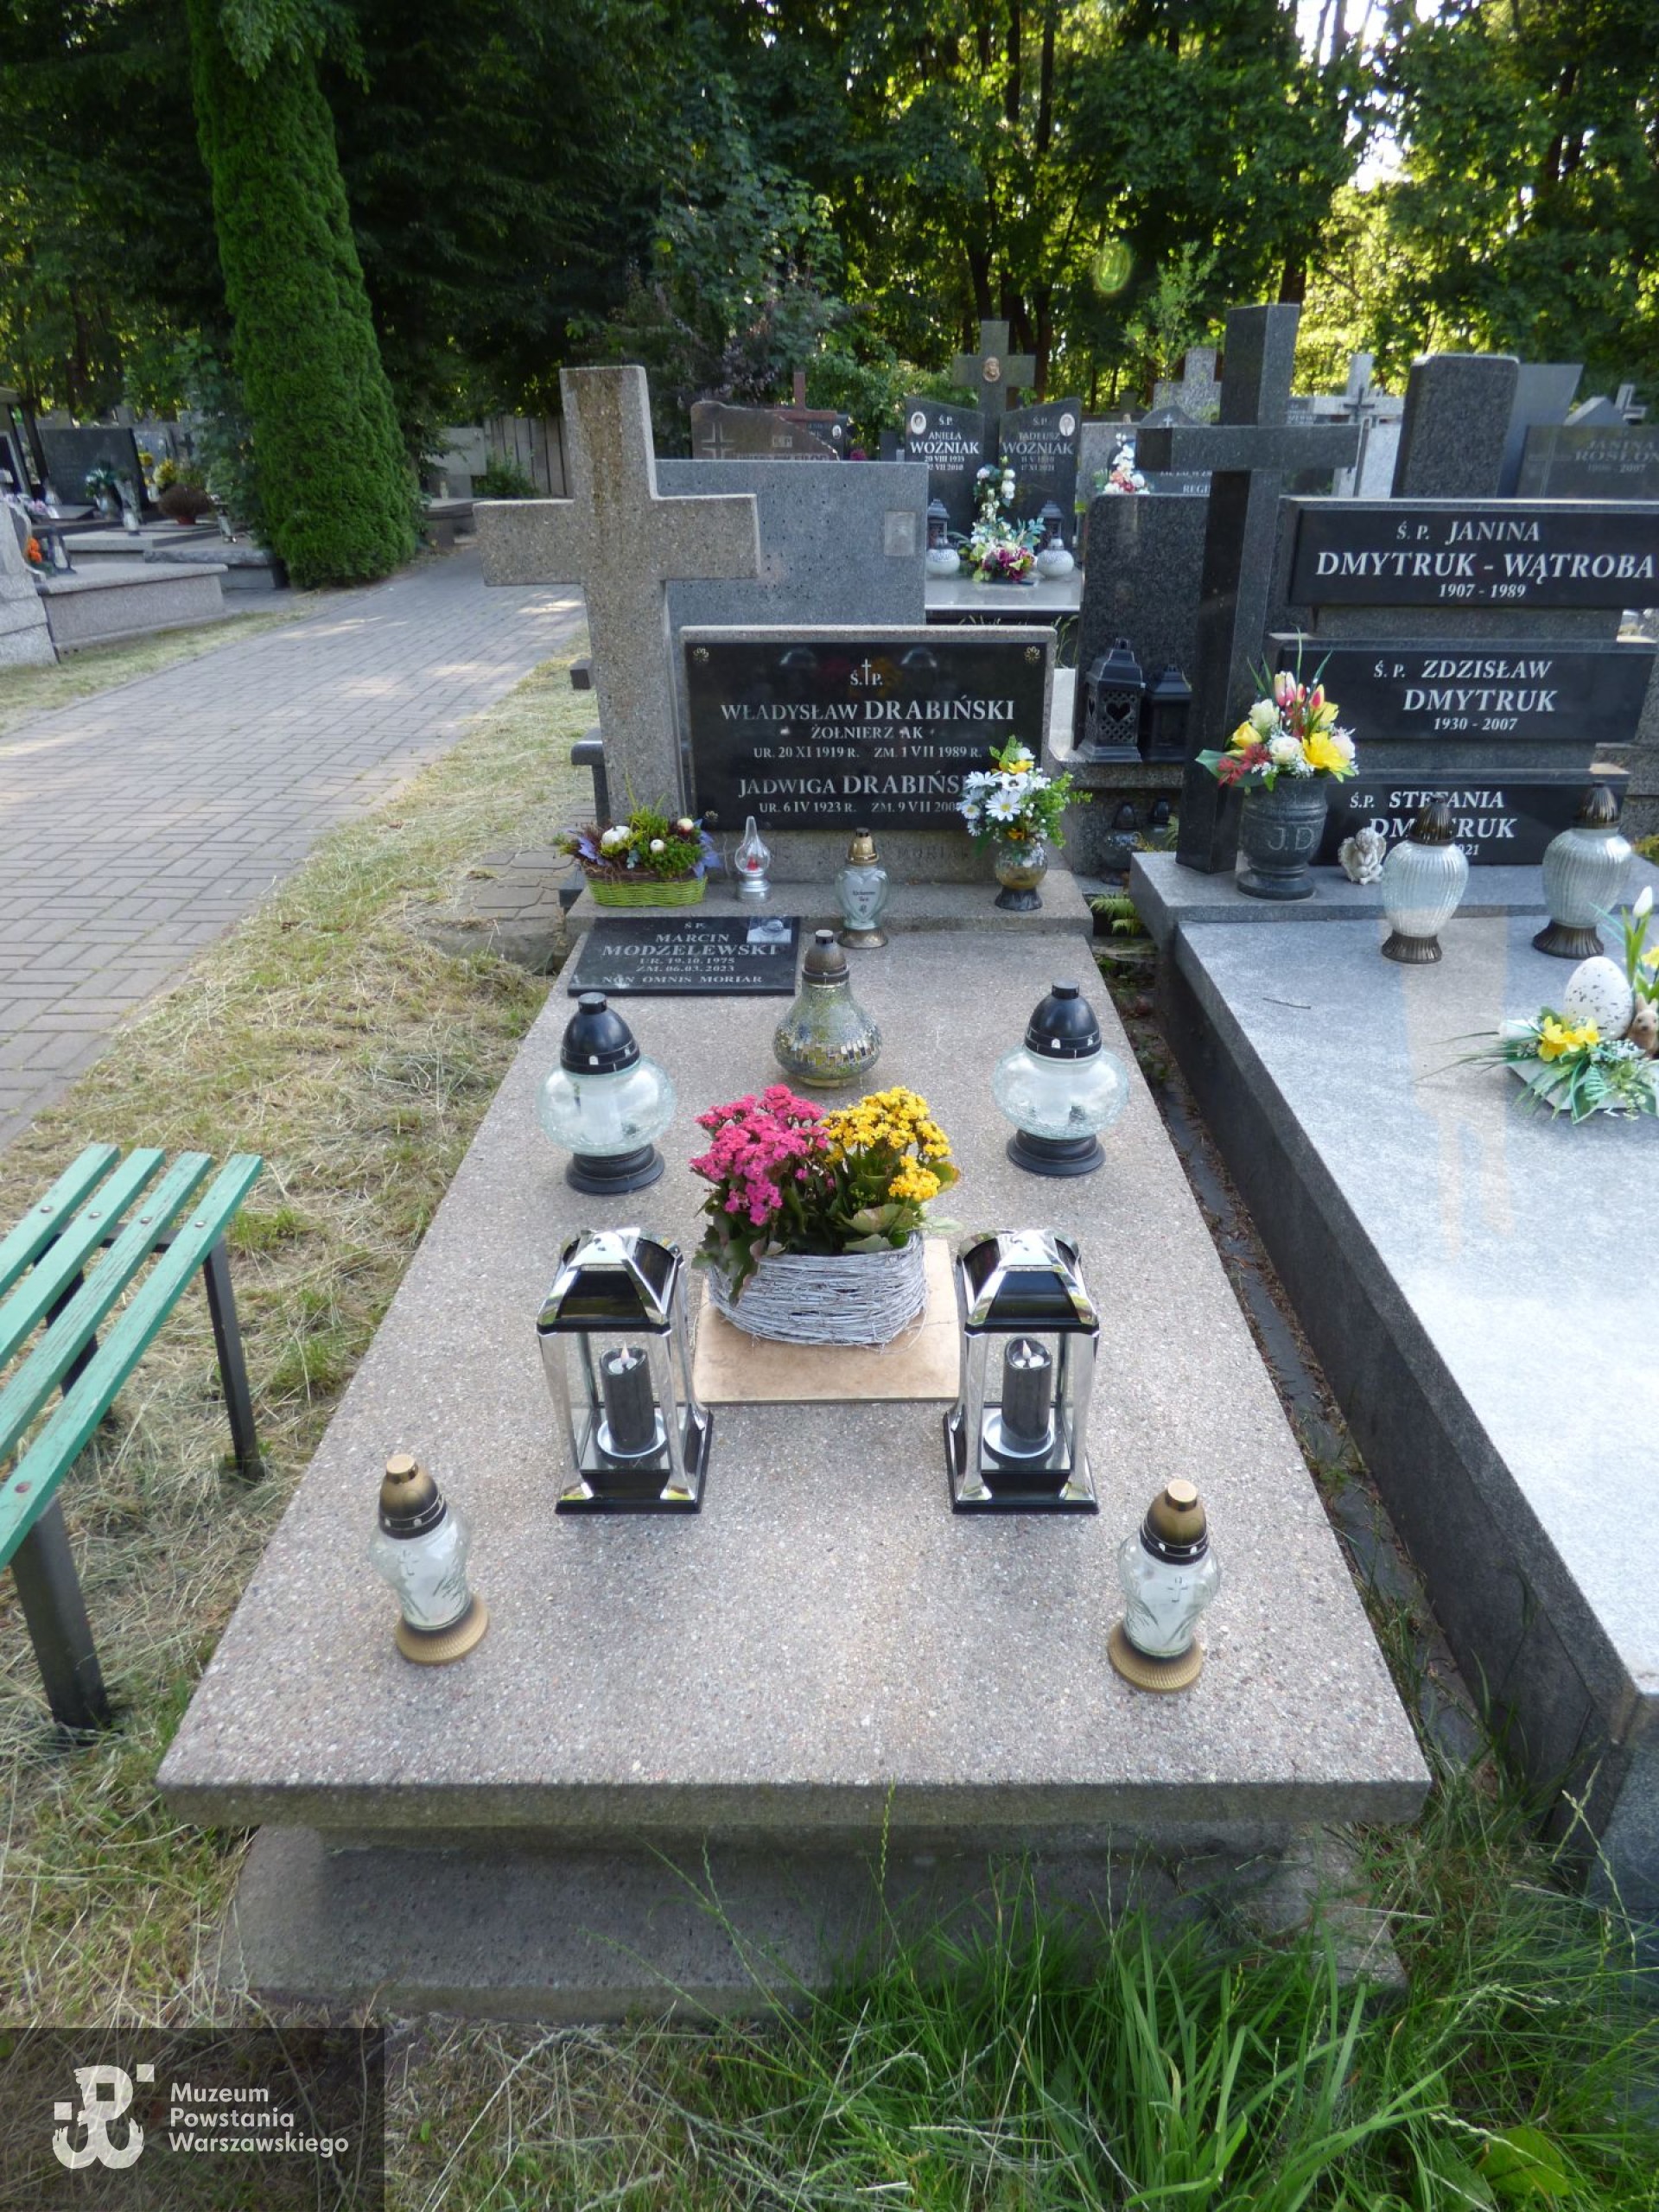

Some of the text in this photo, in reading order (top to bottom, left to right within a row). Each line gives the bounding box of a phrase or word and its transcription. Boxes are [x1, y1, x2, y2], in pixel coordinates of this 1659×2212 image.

[928, 431, 962, 441] ANIELA
[1019, 432, 1061, 441] TADEUSZ
[910, 441, 979, 454] WOŹNIAK
[1002, 441, 1075, 454] WOŹNIAK
[1445, 521, 1539, 545] JANINA
[1315, 552, 1477, 577] DMYTRUK
[1503, 553, 1655, 585] WĄTROBA
[1439, 583, 1475, 598] 1907
[1491, 583, 1527, 598] 1989
[1421, 660, 1553, 679] ZDZISŁAW
[720, 695, 1014, 720] WŁADYSŁAW DRABIŃSKI
[1402, 689, 1558, 712] DMYTRUK
[1433, 717, 1468, 730] 1930
[1482, 717, 1518, 731] 2007
[810, 723, 923, 740] ŻOŁNIERZ AK
[753, 747, 774, 758] UR.
[778, 747, 792, 758] 20
[796, 747, 812, 758] XI
[816, 747, 844, 758] 1919
[847, 747, 860, 758] R.
[911, 747, 934, 758] VII
[939, 747, 967, 758] 1989
[738, 779, 836, 798] JADWIGA
[759, 803, 781, 813] UR.
[784, 802, 791, 812] 6
[794, 802, 810, 812] IV
[813, 802, 841, 812] 1923
[844, 803, 857, 813] R.
[871, 802, 895, 813] ZM.
[898, 802, 906, 812] 9
[908, 802, 931, 812] VII
[1369, 818, 1518, 838] DMRUK
[656, 933, 729, 942] MARCIN
[601, 944, 778, 956] MODZELEWSKI
